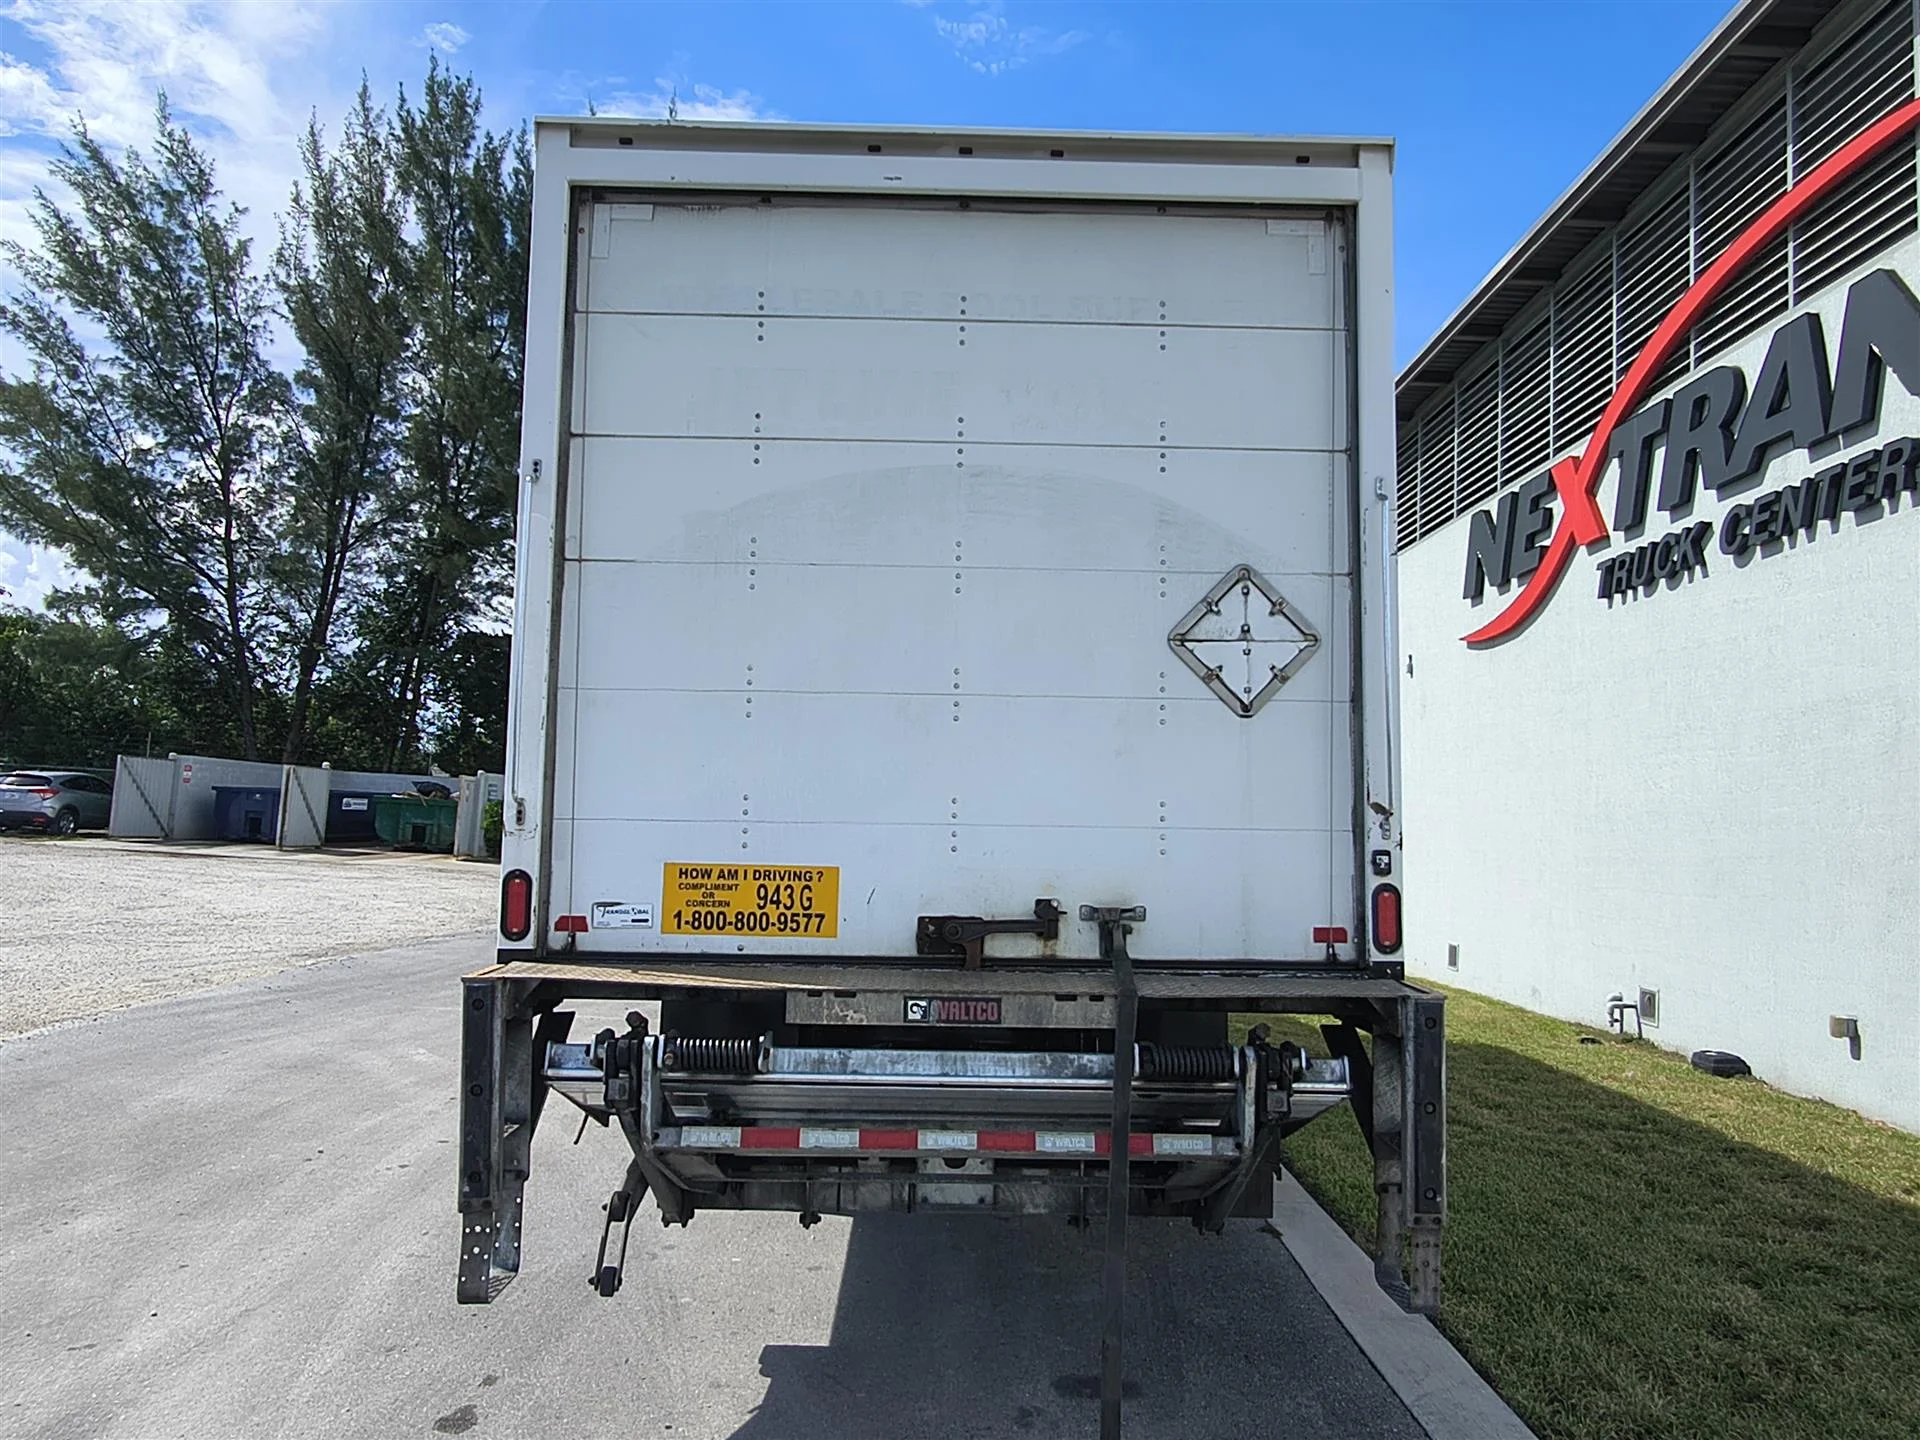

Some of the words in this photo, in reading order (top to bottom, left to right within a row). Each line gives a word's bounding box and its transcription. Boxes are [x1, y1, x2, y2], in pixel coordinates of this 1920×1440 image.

[1597, 520, 1713, 600] TRUCK
[678, 867, 713, 880] HOW
[717, 868, 739, 881] AM
[743, 868, 748, 881] I
[678, 882, 740, 891] COMPLIMENT
[701, 891, 716, 900] OR
[685, 899, 731, 908] CONCERN
[673, 909, 826, 934] 1-800-800-9577
